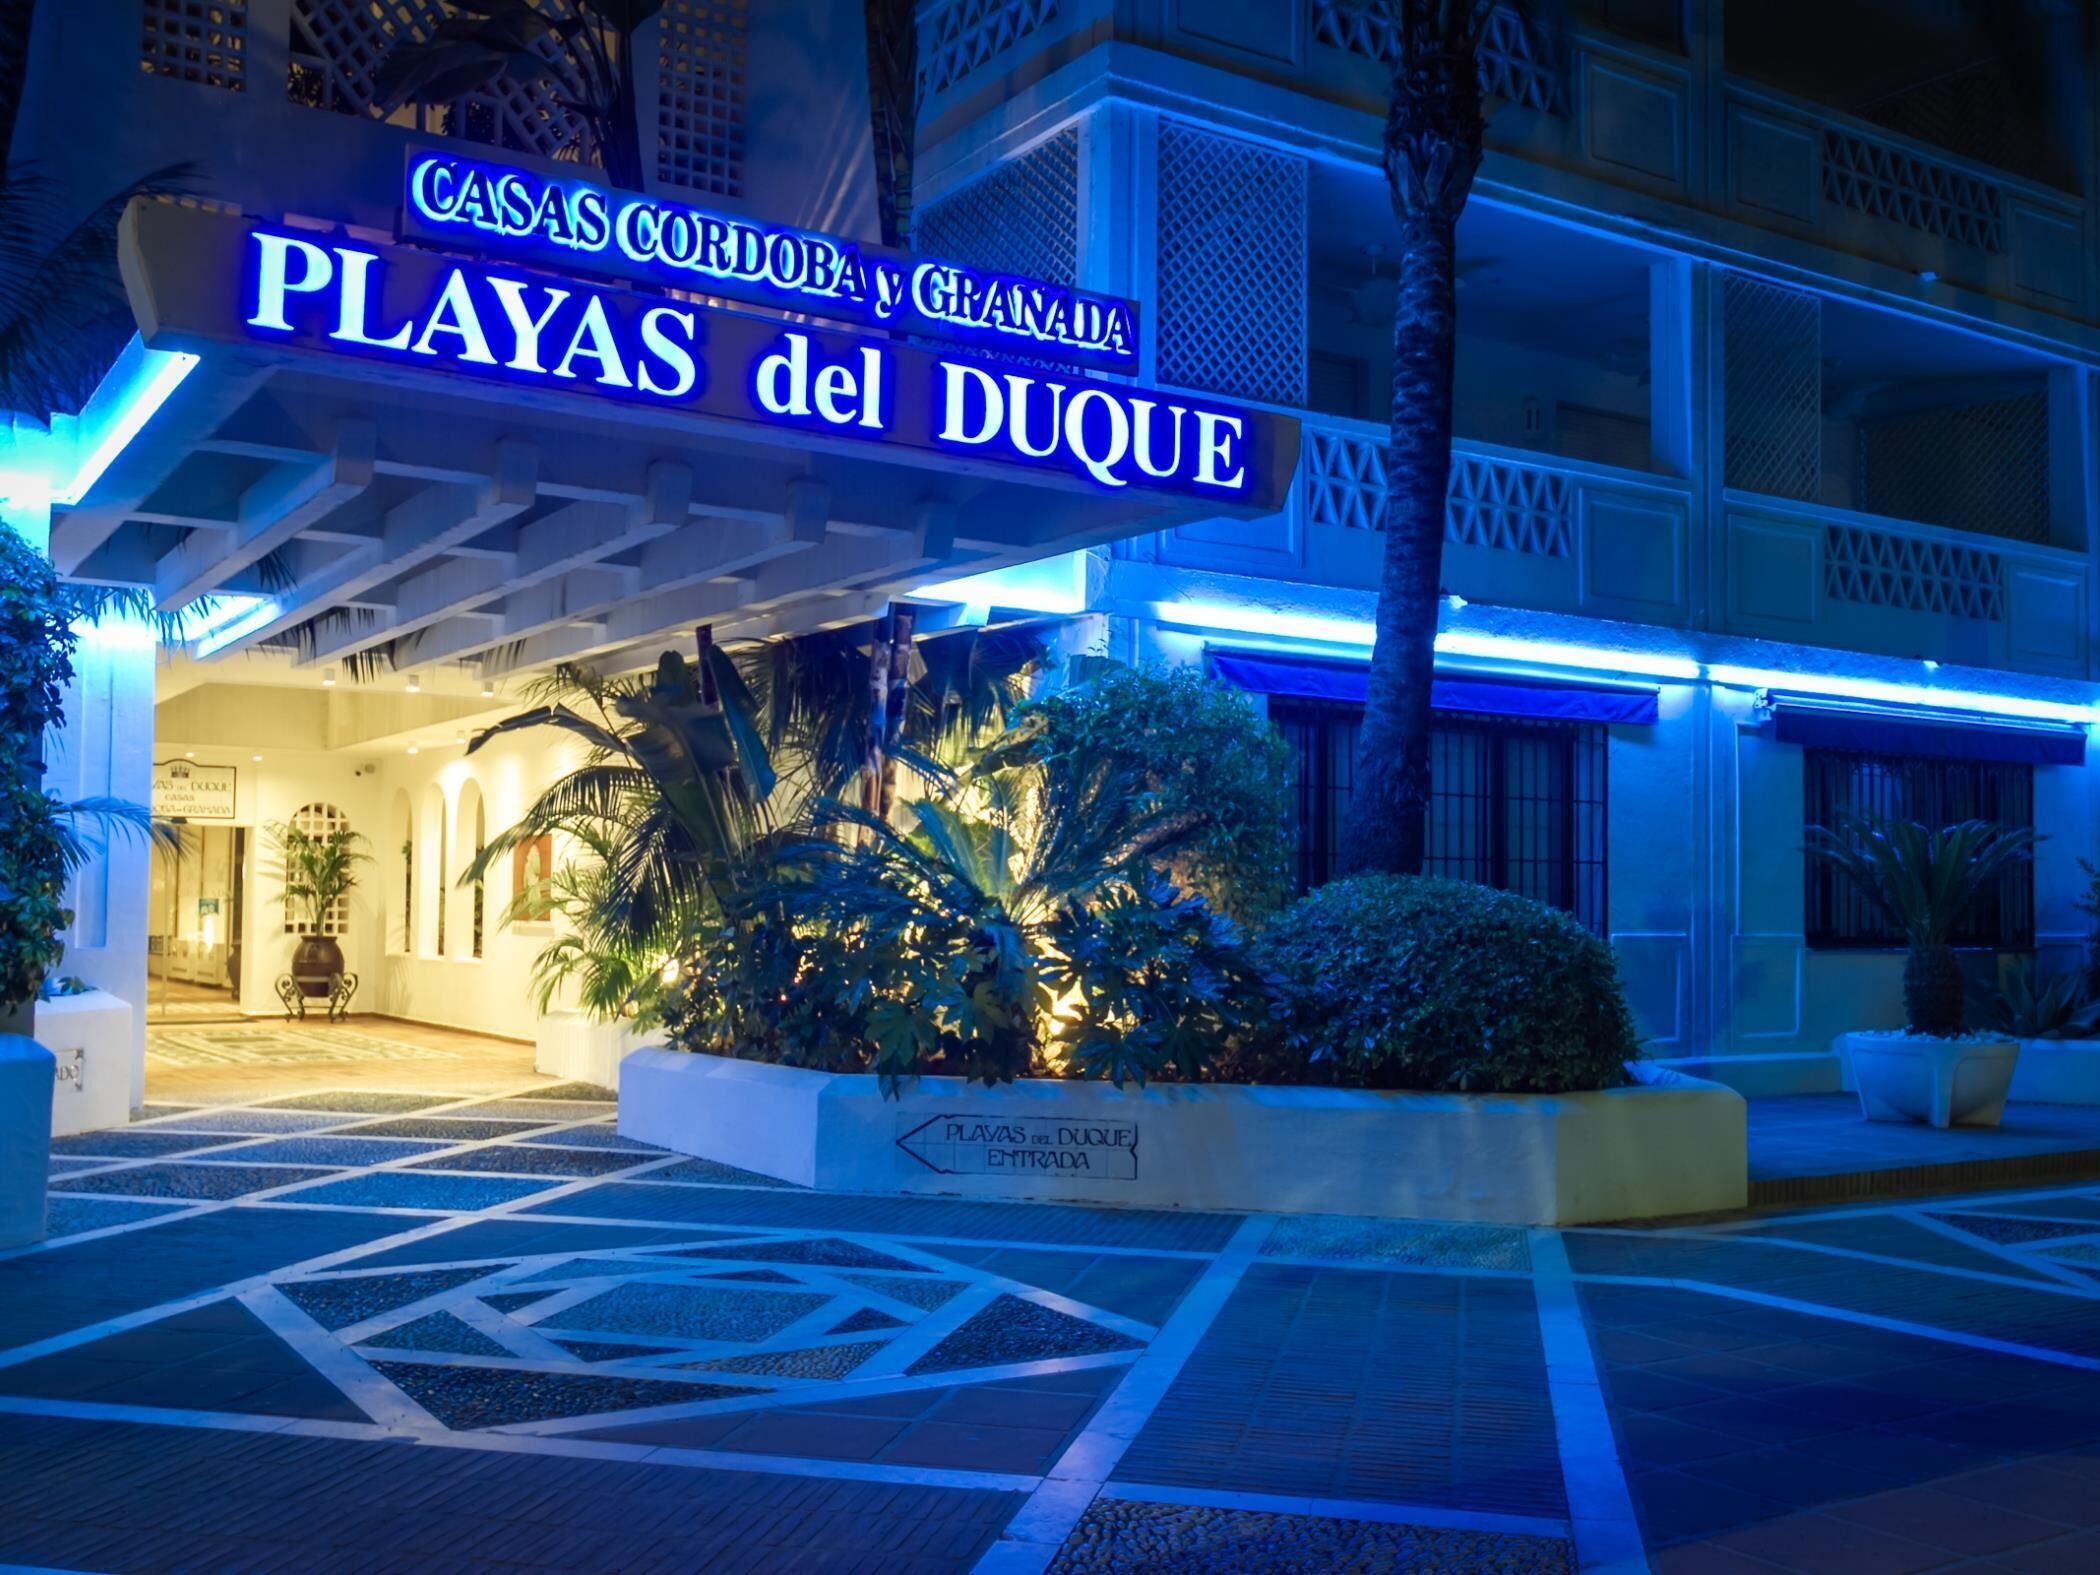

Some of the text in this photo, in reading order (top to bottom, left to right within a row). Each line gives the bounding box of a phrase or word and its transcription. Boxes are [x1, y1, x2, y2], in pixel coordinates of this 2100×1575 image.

[412, 157, 1134, 355] CASAS CORDOBA y GRANADA
[247, 231, 1245, 486] PLAYAS del DUQUE
[946, 1123, 1132, 1147] PLAYAS DEL DUQUE
[988, 1149, 1090, 1170] ENTRADA
